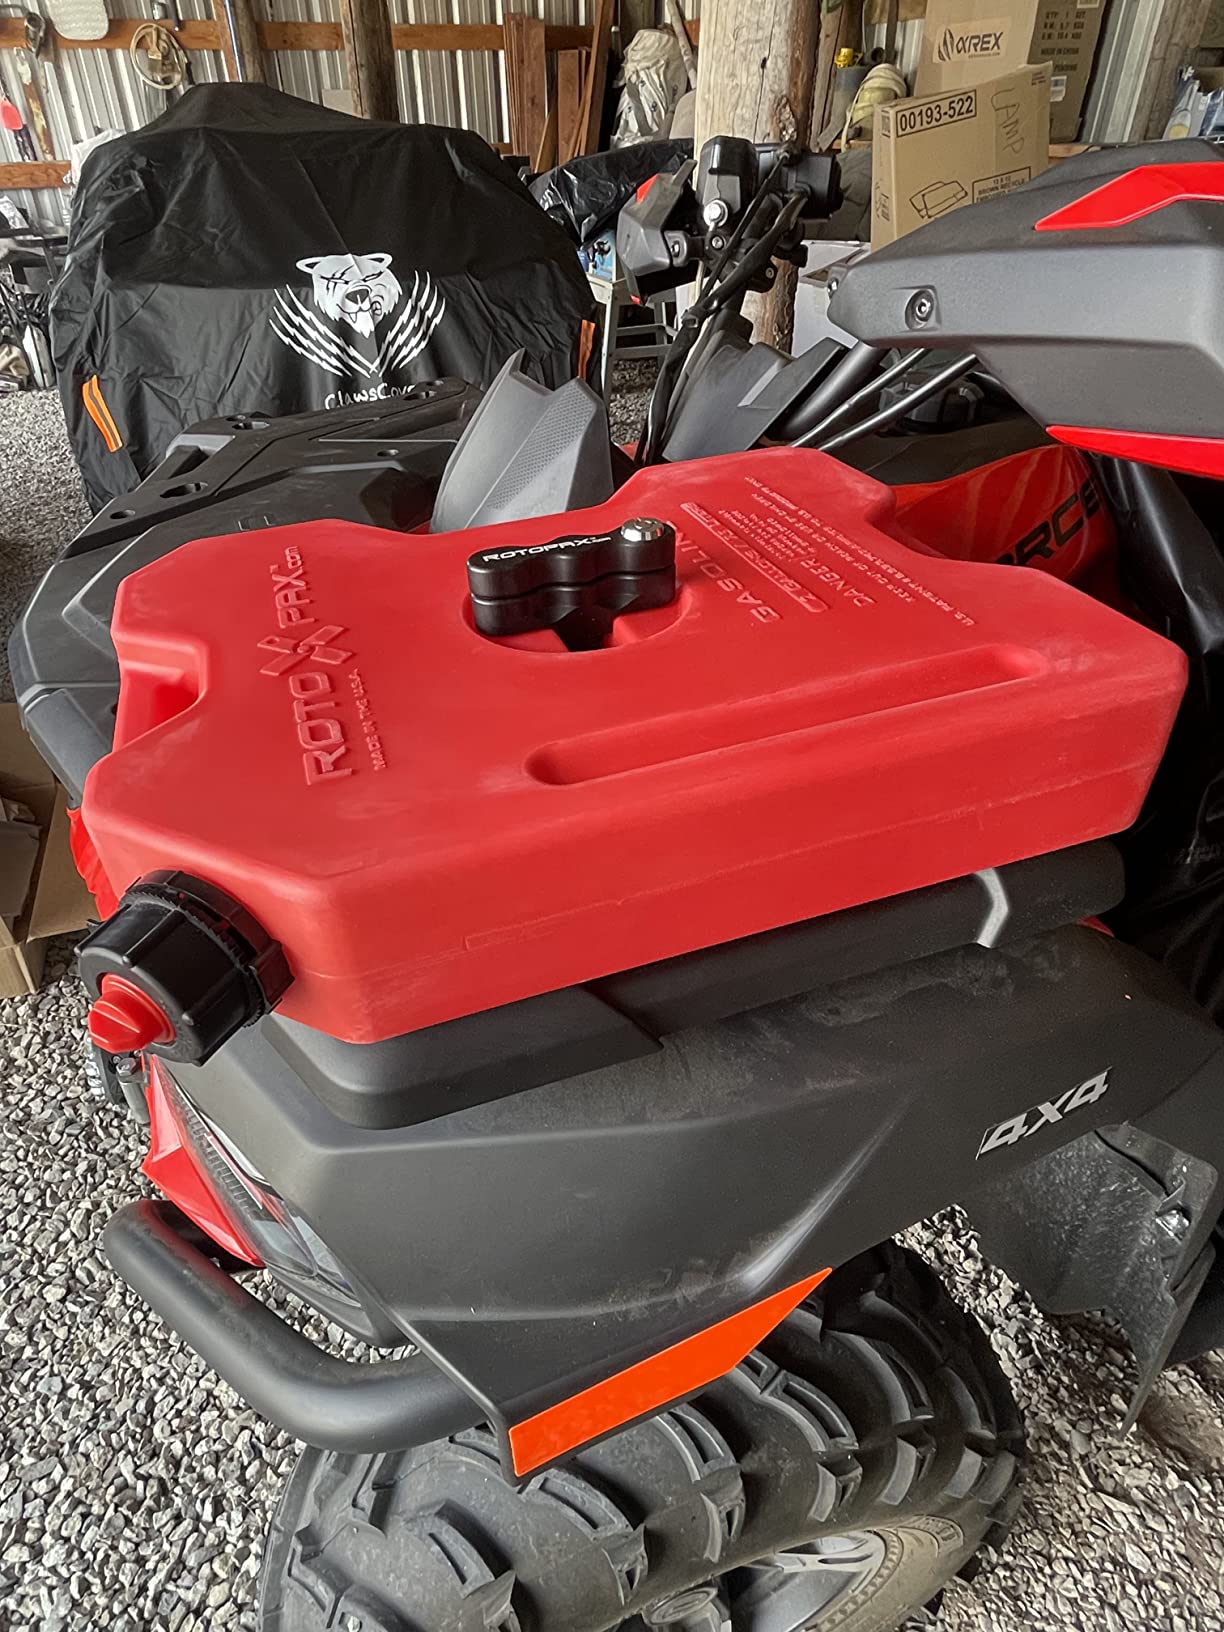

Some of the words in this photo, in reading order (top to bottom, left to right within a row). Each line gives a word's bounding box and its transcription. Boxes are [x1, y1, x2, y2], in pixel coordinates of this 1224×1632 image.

[899, 94, 974, 132] 00193-522
[482, 537, 591, 562] ROTOPAX
[800, 557, 877, 607] DANGER
